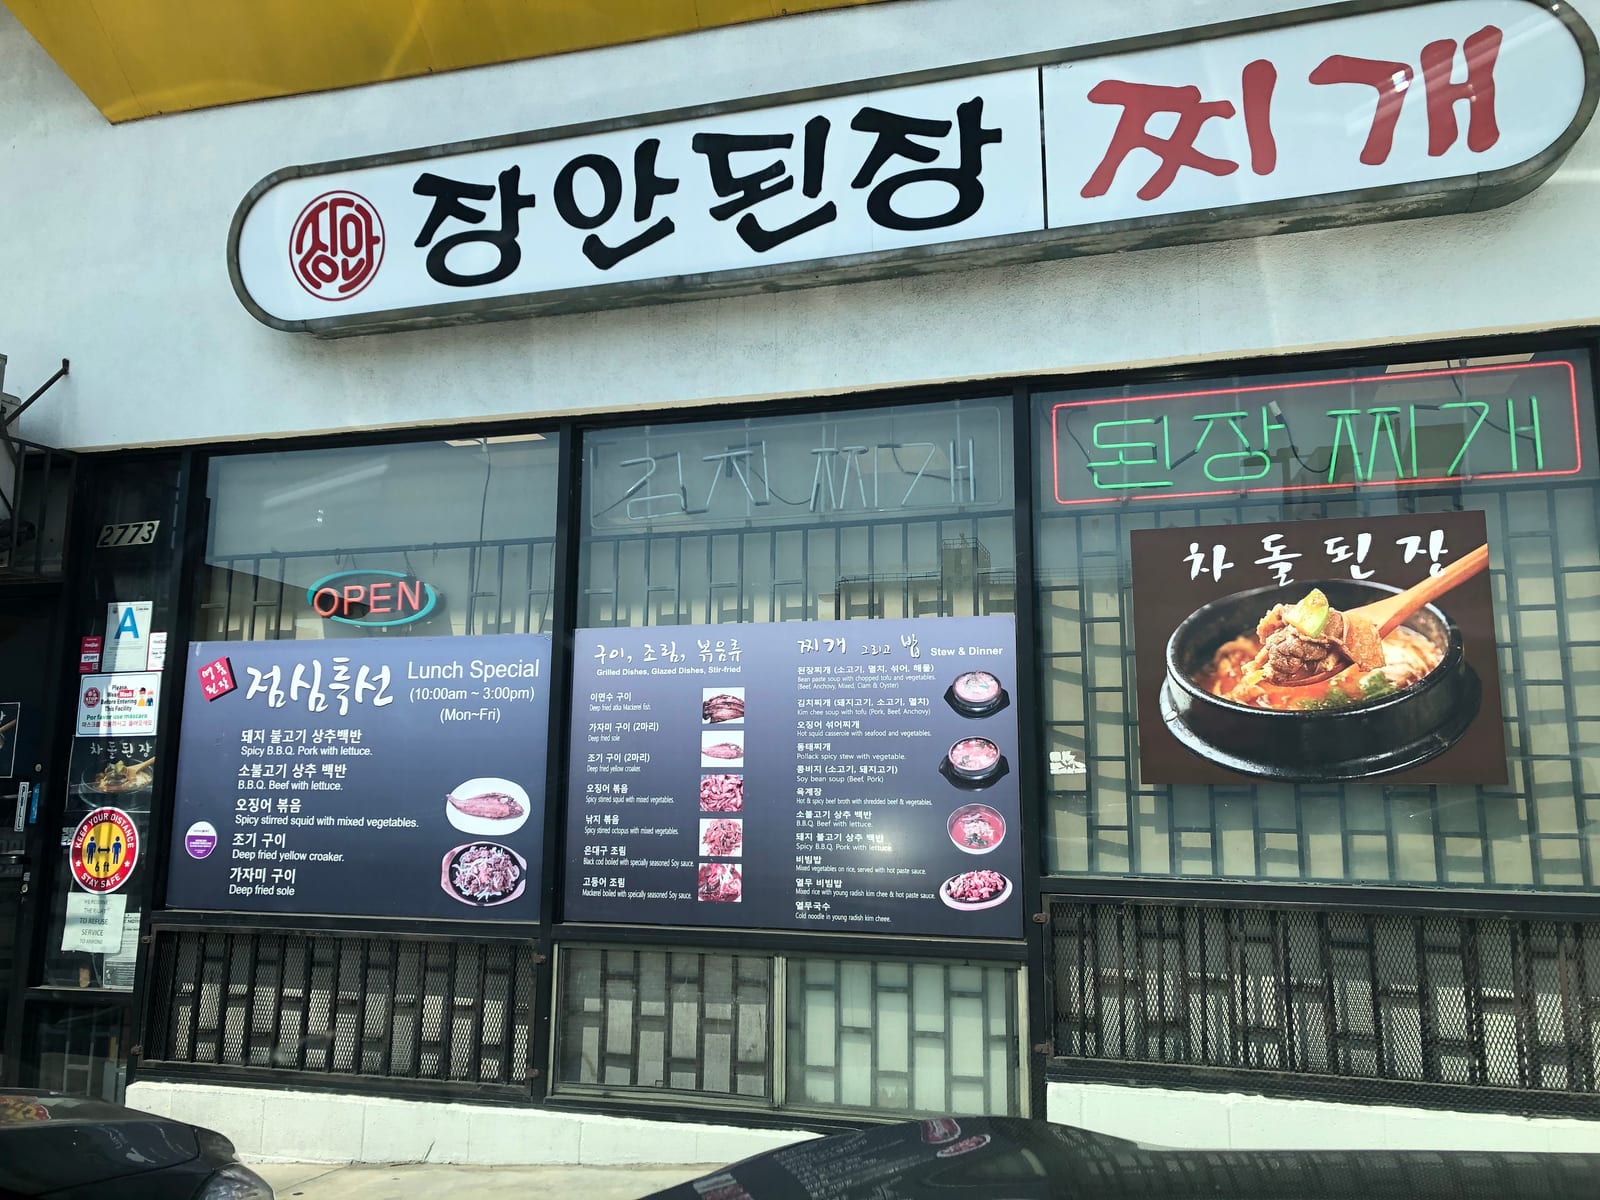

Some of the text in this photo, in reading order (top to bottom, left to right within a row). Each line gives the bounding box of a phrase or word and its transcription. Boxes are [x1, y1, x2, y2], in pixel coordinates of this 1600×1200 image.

[413, 24, 1503, 288] 장안된장 찌개
[1086, 395, 1543, 489] 된장 찌개
[809, 437, 975, 512] 찌개
[102, 523, 154, 545] 2773
[314, 580, 420, 618] OPEN
[114, 607, 139, 639] A
[594, 638, 742, 664] 구이, 조림, 볶음류
[797, 638, 847, 654] 찌개
[861, 645, 891, 655] 그리고
[930, 647, 956, 656] Stew
[958, 647, 966, 656] &
[969, 646, 1004, 656] Dinner
[408, 659, 539, 680] Lunch Special
[678, 666, 707, 674] Dishes,
[246, 657, 394, 716] 점심특선
[410, 687, 466, 702] (10:00am
[483, 686, 534, 702] 3:00pm)
[617, 692, 632, 701] 구이
[440, 708, 500, 723] (Mon~Fri)
[589, 722, 611, 732] 가자미
[616, 722, 630, 732] 구이
[797, 720, 822, 729] 오징어
[241, 728, 362, 743] 돼지 불고기 상추백반
[241, 745, 372, 757] Spicy B.B.Q. Pork with lettuce.
[588, 753, 602, 762] 조기
[606, 753, 620, 762] 구이
[238, 763, 346, 778] 소불고기 상추 백반
[238, 779, 342, 790] B.B.Q. Beef with lettuce.
[797, 775, 808, 783] Soy
[587, 783, 609, 793] 오징어
[235, 797, 301, 812] 오징어 볶음
[235, 814, 419, 829] Spicy stirred squid with mixed vegetables.
[833, 818, 846, 826] with
[75, 813, 134, 848] KEEP YOUR DISTANCE
[232, 832, 286, 848] 조기 구이
[232, 848, 344, 862] Deep fried yellow croaker.
[94, 862, 109, 872] 6 ft
[81, 872, 120, 888] STAY SAFE
[230, 867, 296, 883] 가자미 구이
[229, 884, 294, 896] Deep fried sole
